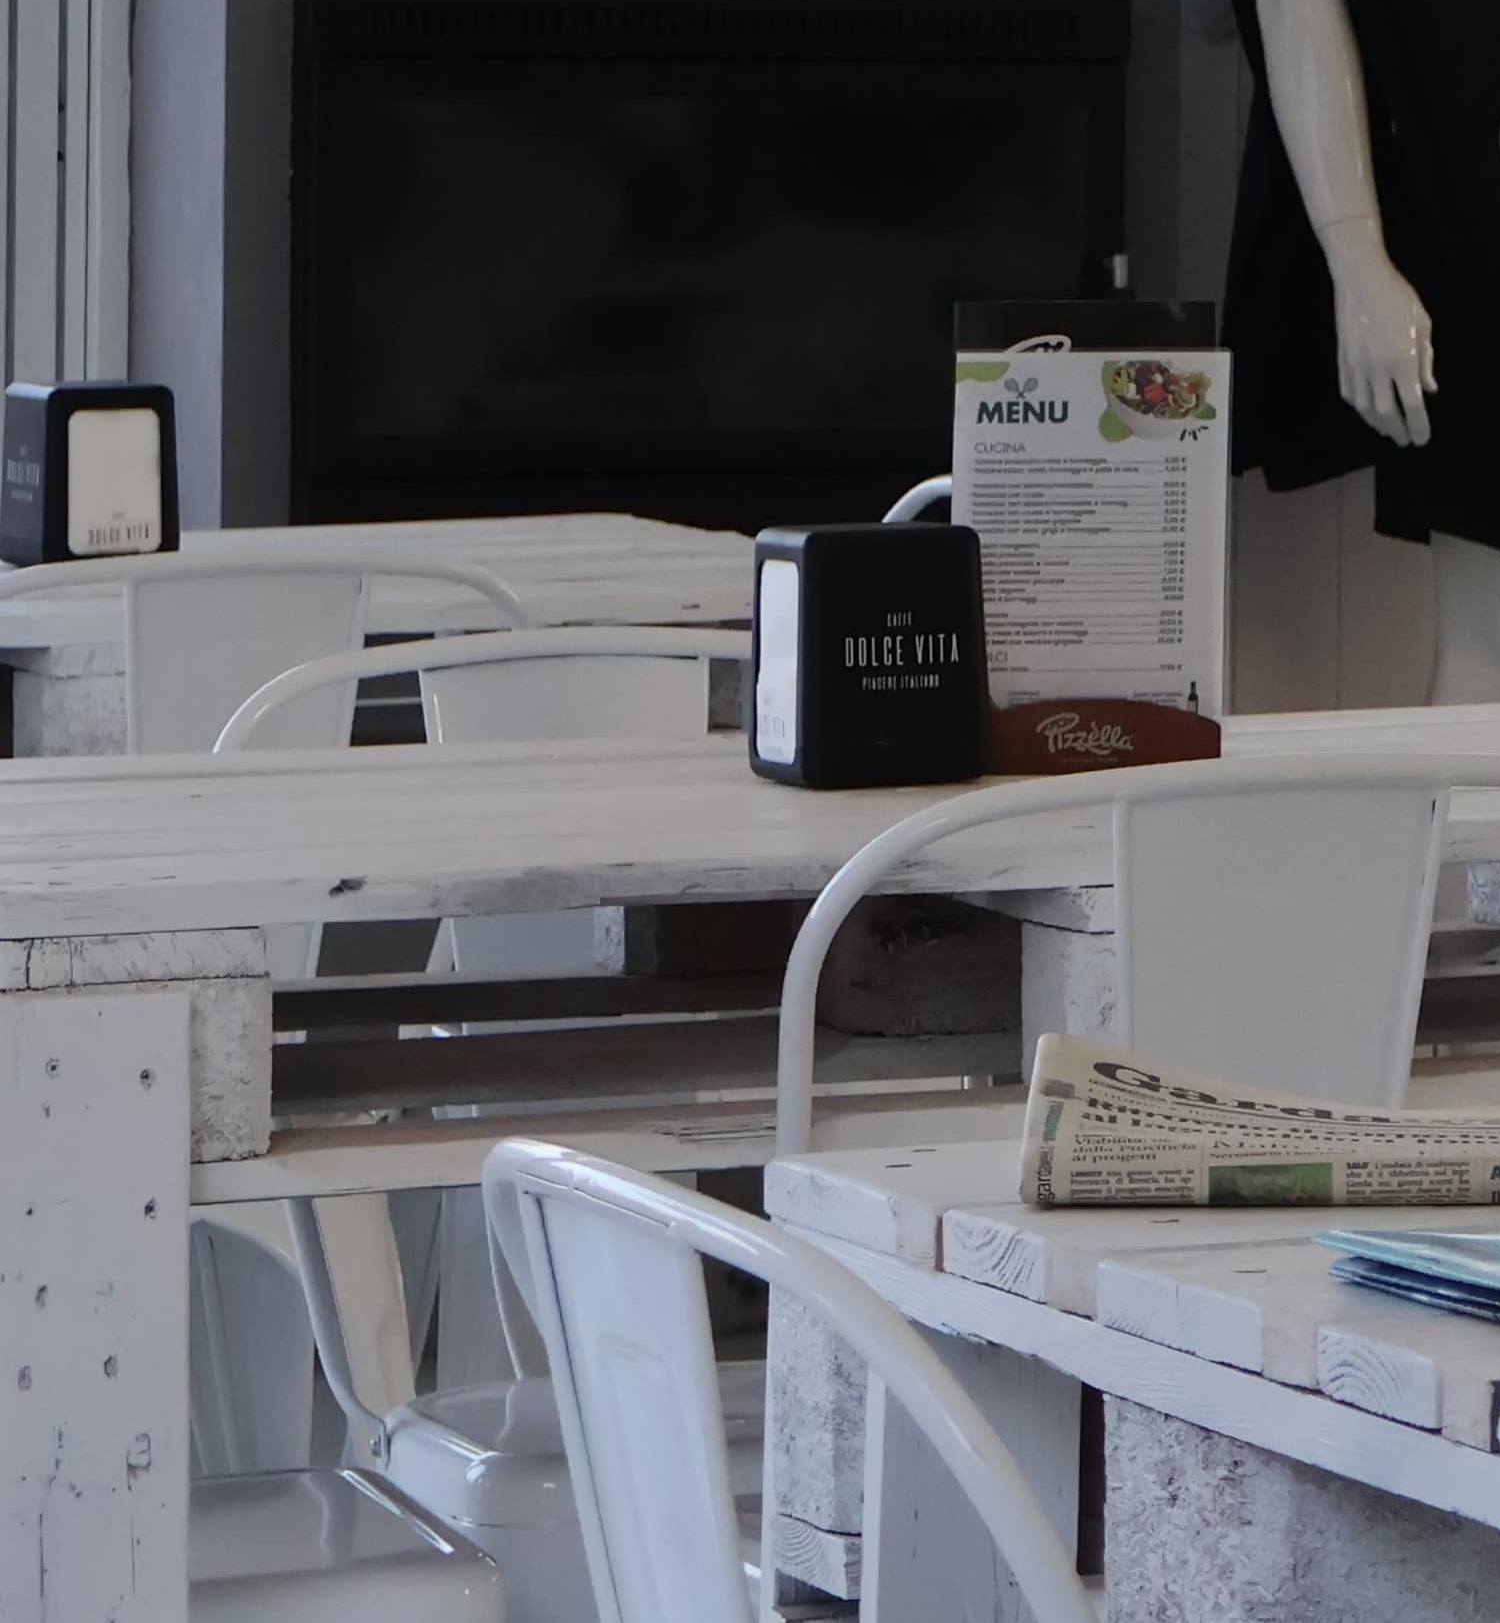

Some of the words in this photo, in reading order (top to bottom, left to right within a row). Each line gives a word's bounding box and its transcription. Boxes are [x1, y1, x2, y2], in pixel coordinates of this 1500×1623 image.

[976, 398, 1071, 426] MENU
[973, 441, 1027, 454] CUCINA
[844, 634, 905, 668] DOLCE
[914, 632, 960, 665] VITA
[862, 674, 898, 692] PIACERE
[900, 673, 941, 690] ITALIANO
